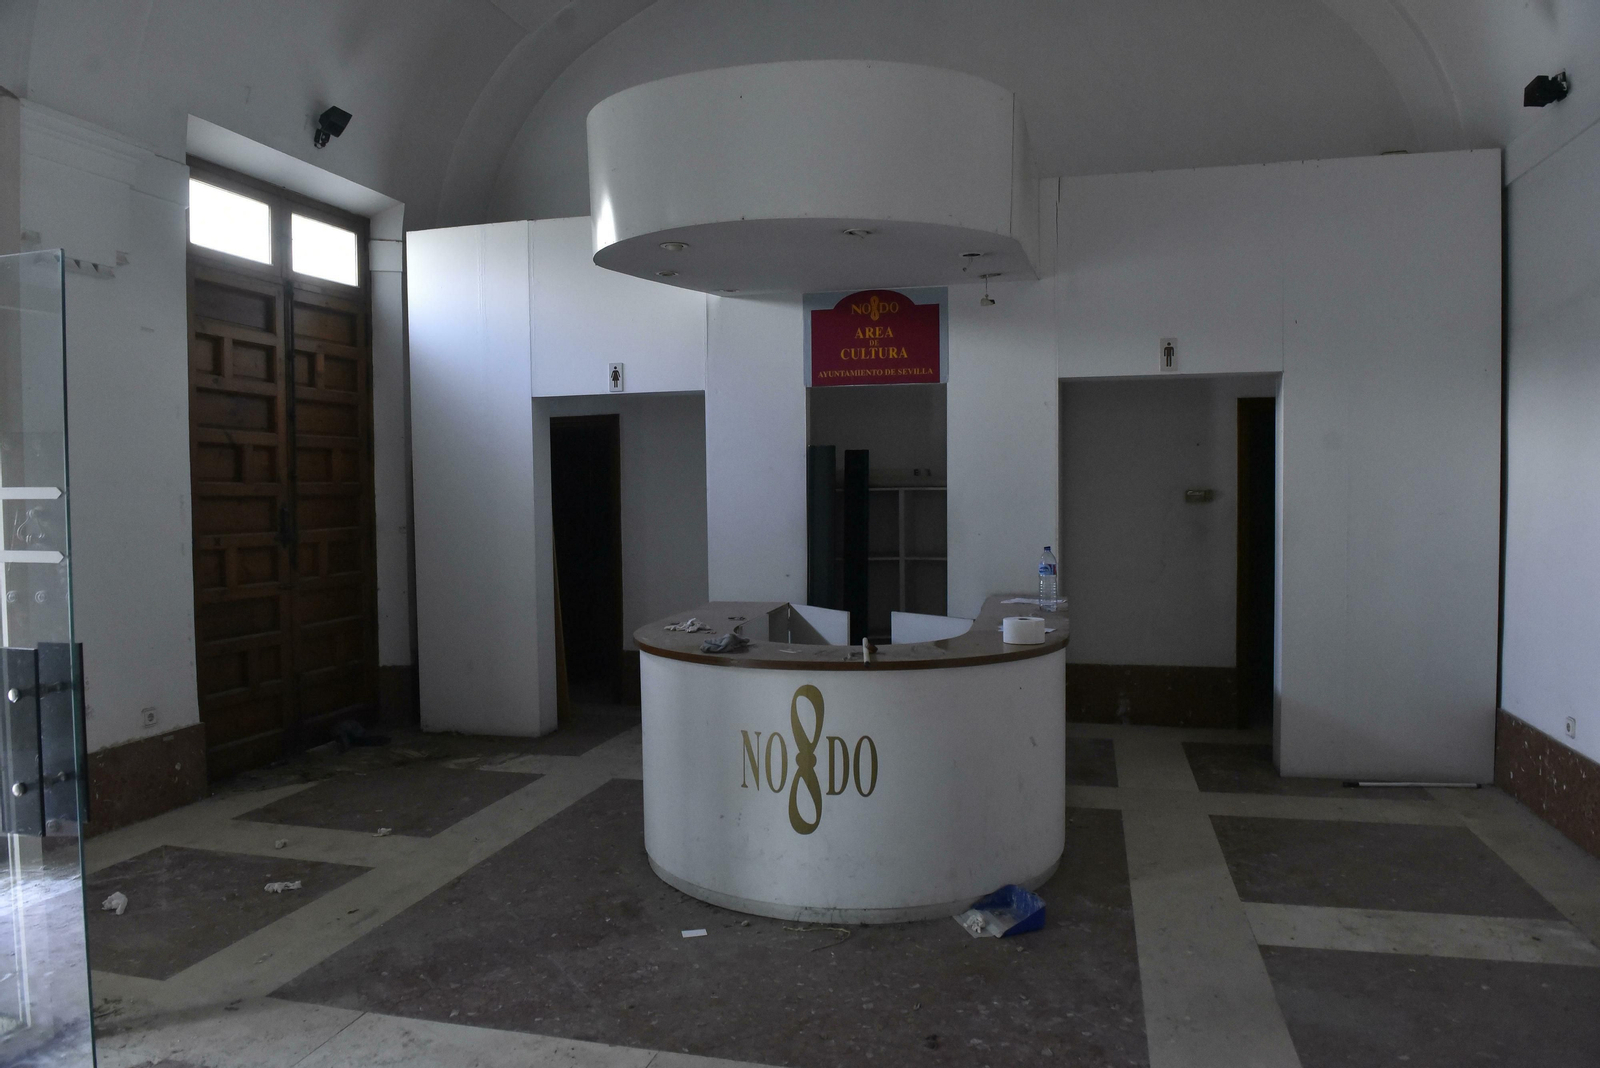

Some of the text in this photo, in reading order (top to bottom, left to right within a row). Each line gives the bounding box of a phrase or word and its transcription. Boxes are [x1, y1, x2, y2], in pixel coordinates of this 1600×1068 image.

[854, 326, 894, 339] AREA
[869, 339, 879, 347] DE
[840, 347, 908, 360] CULTURA
[818, 369, 883, 378] AYUNTAMIENTO
[897, 367, 933, 375] SEVILLA
